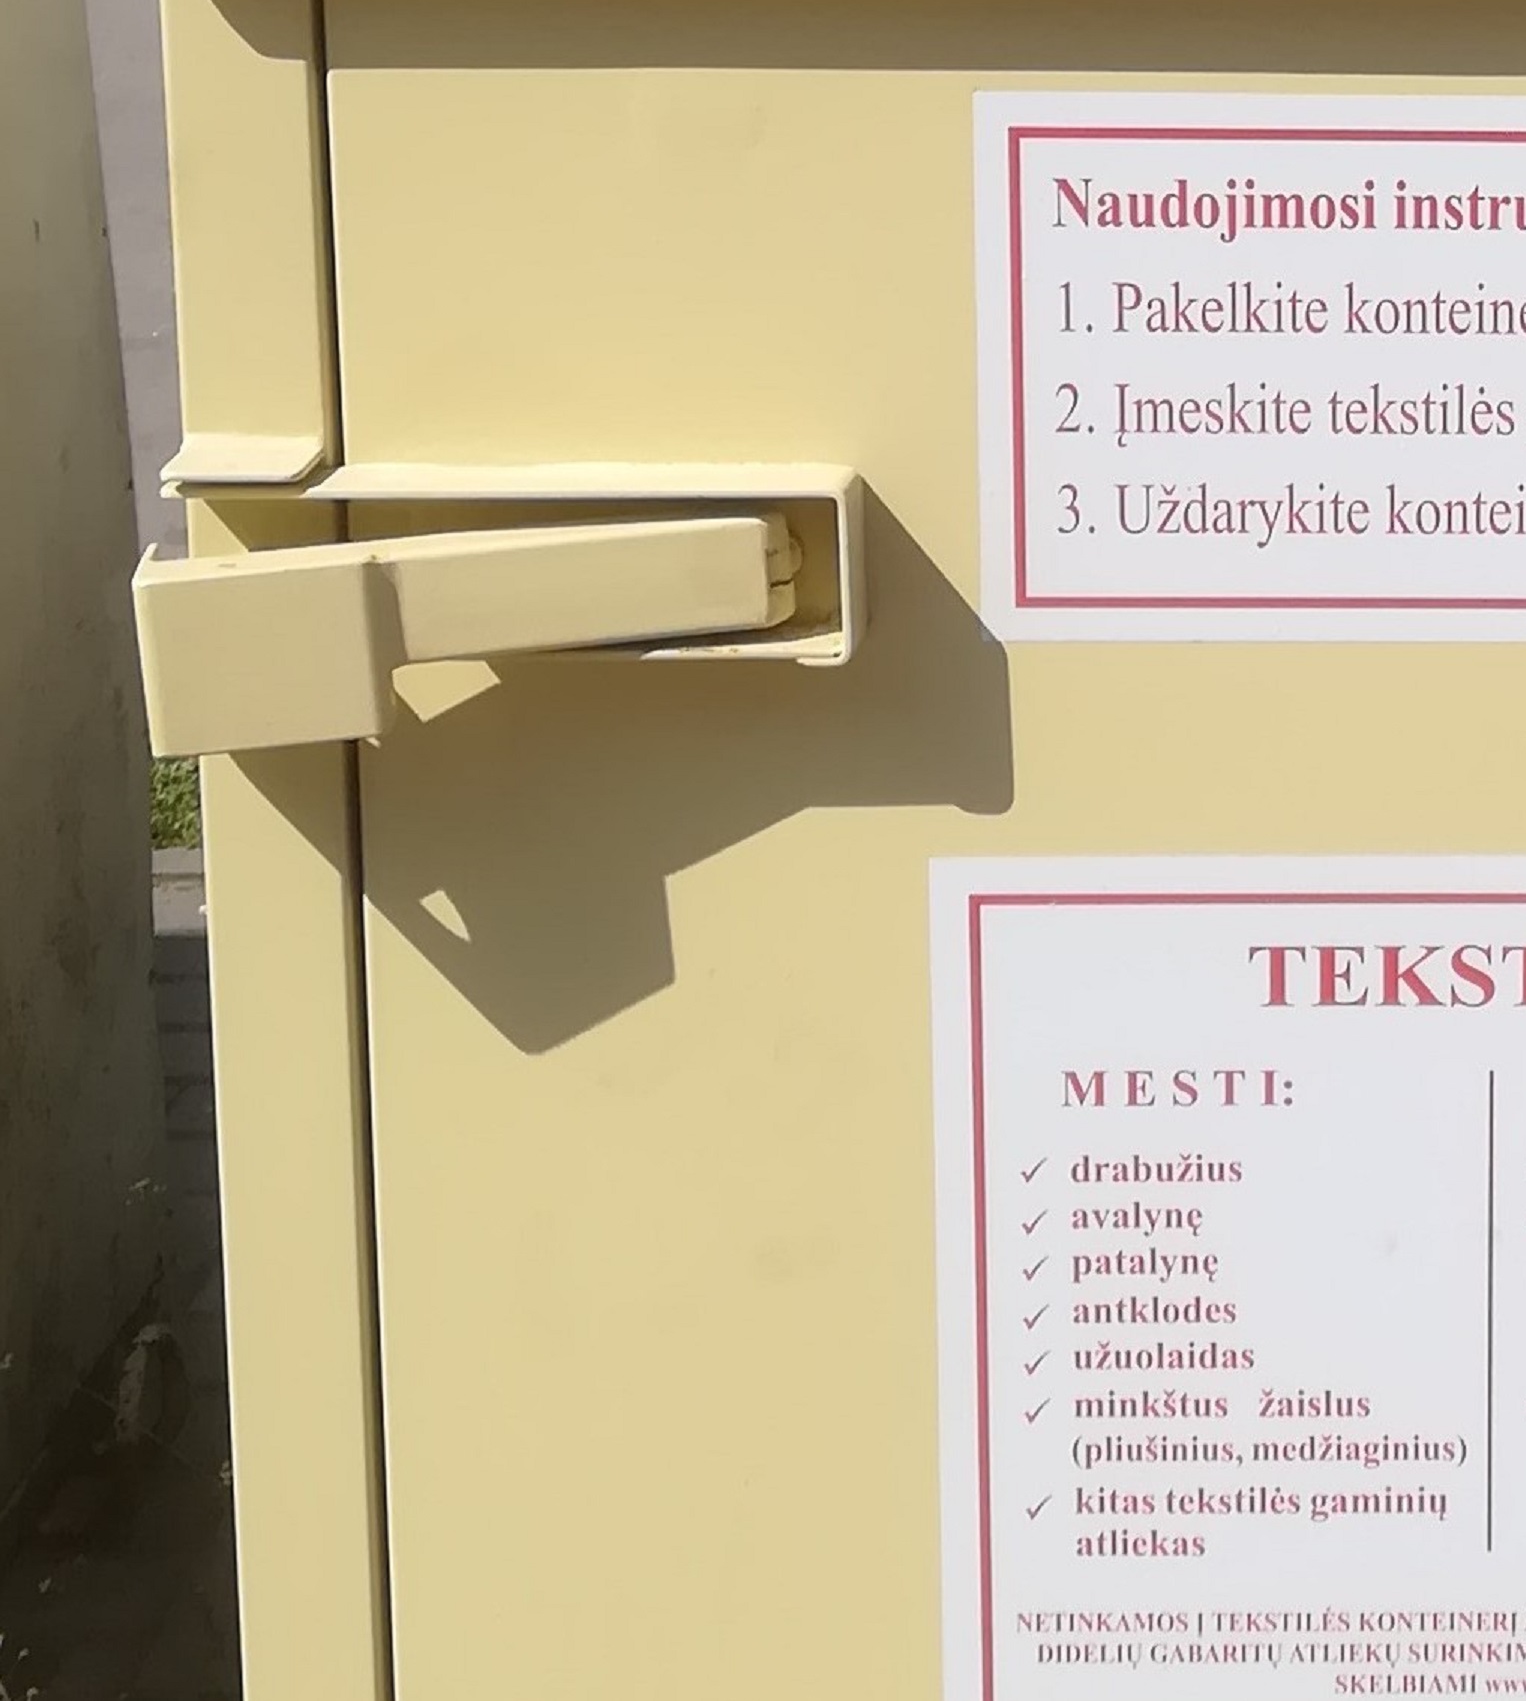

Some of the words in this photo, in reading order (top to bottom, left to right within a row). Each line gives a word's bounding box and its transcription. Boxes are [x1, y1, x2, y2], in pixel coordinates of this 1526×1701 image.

[1051, 177, 1377, 244] Naudojimosi
[1058, 281, 1094, 334] 1.
[1111, 280, 1329, 335] Pakelkite
[1054, 382, 1095, 435] 2.
[1113, 381, 1312, 449] Įmeskite
[1327, 382, 1515, 436] tekstilės
[1057, 482, 1096, 535] 3.
[1113, 482, 1371, 550] Uždarykite
[1061, 1069, 1294, 1108] MESTI:
[1070, 1152, 1243, 1184] drabužius
[1071, 1200, 1203, 1238] avalynę
[1072, 1246, 1219, 1285] patalynę
[1072, 1295, 1237, 1325] antklodes
[1073, 1340, 1255, 1371] užuolaidas
[1074, 1388, 1229, 1419] minkštus
[1258, 1387, 1371, 1419] žaislus
[1072, 1434, 1244, 1471] (pliušinius,
[1252, 1433, 1468, 1470] medžiaginius)
[1075, 1485, 1156, 1515] kitas
[1165, 1485, 1301, 1516] tekstilės
[1310, 1485, 1447, 1523] gaminių
[1076, 1528, 1206, 1558] atliekas
[1016, 1611, 1189, 1633] NETINKAMOS
[1359, 1610, 1518, 1638] KONTEINERĮ
[1037, 1643, 1142, 1670] DIDELIŲ
[1150, 1642, 1282, 1670] GABARITŲ
[1289, 1642, 1401, 1669] ATLIEKŲ
[1334, 1673, 1477, 1695] SKELBIAMI
